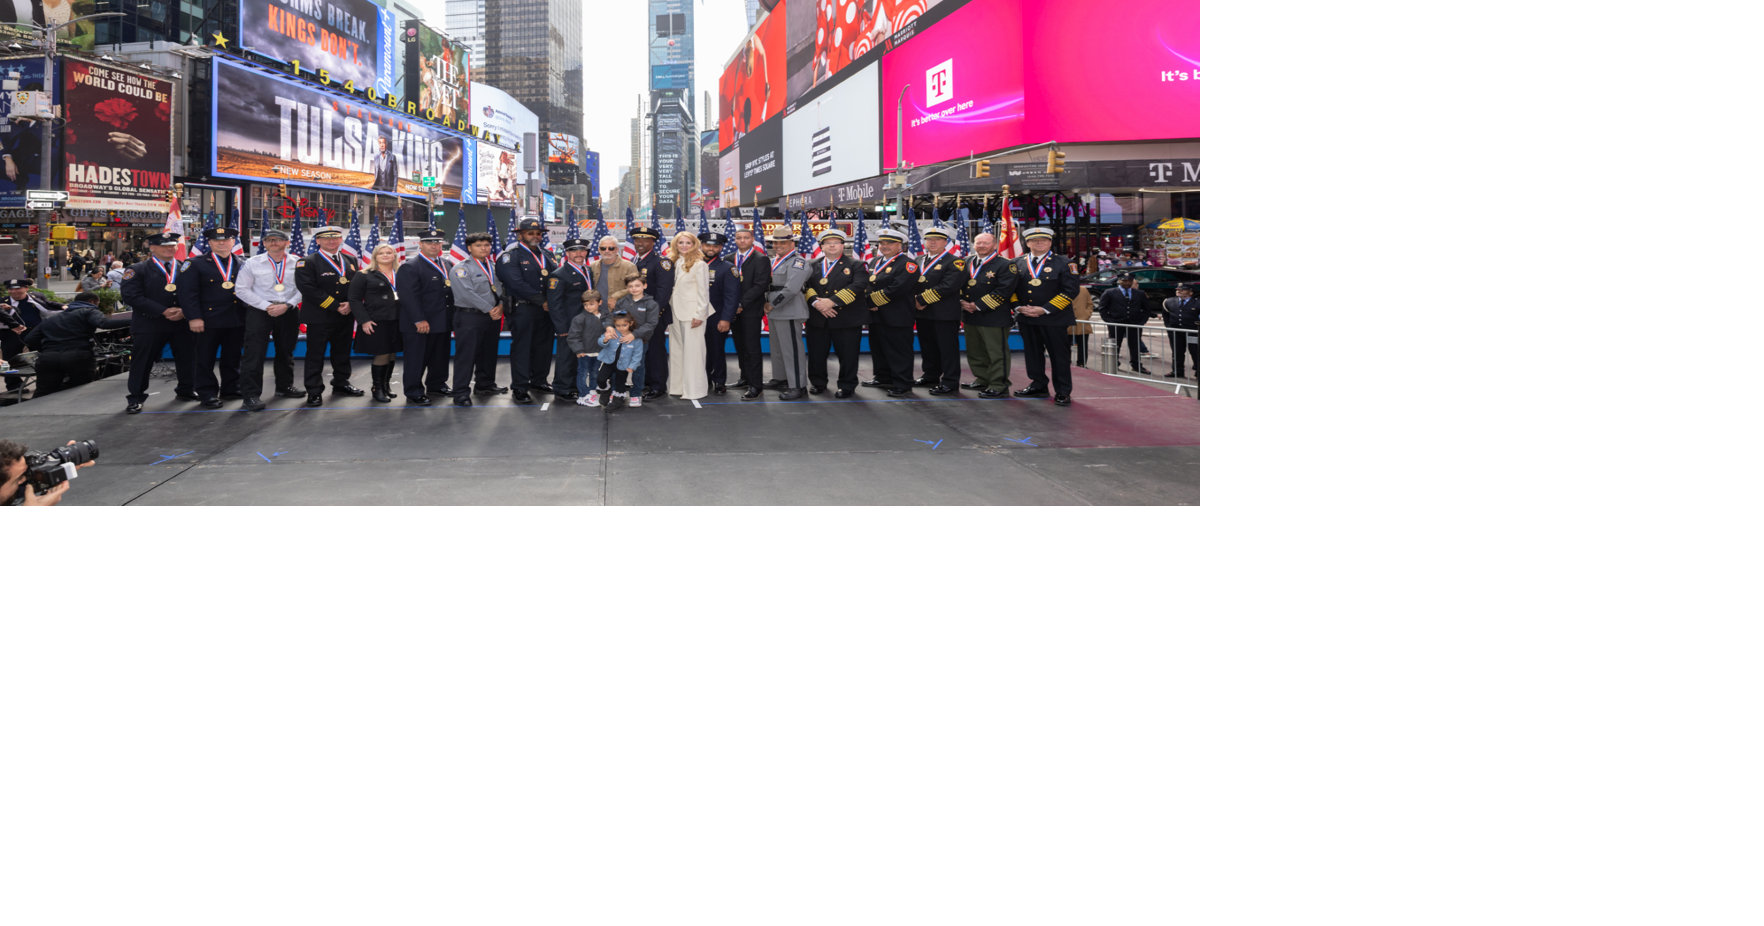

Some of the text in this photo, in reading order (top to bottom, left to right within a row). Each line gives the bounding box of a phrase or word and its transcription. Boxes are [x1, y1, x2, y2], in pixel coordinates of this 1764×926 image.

[268, 4, 362, 66] KINGS DON'T.
[327, 3, 370, 44] BREAK.
[73, 71, 168, 103] WORLD COULD BE
[88, 66, 156, 90] COME SEE HOW THE
[1161, 70, 1189, 82] It's
[333, 101, 412, 133] STALLONE
[911, 100, 974, 128] It's better over here
[275, 95, 444, 185] TULSA KING
[69, 163, 170, 189] HADESTOWN
[280, 166, 332, 181] NEW SEASON
[69, 183, 113, 191] BROADWAY'S
[71, 208, 108, 218] GIFTS
[790, 196, 812, 208] EPHRA
